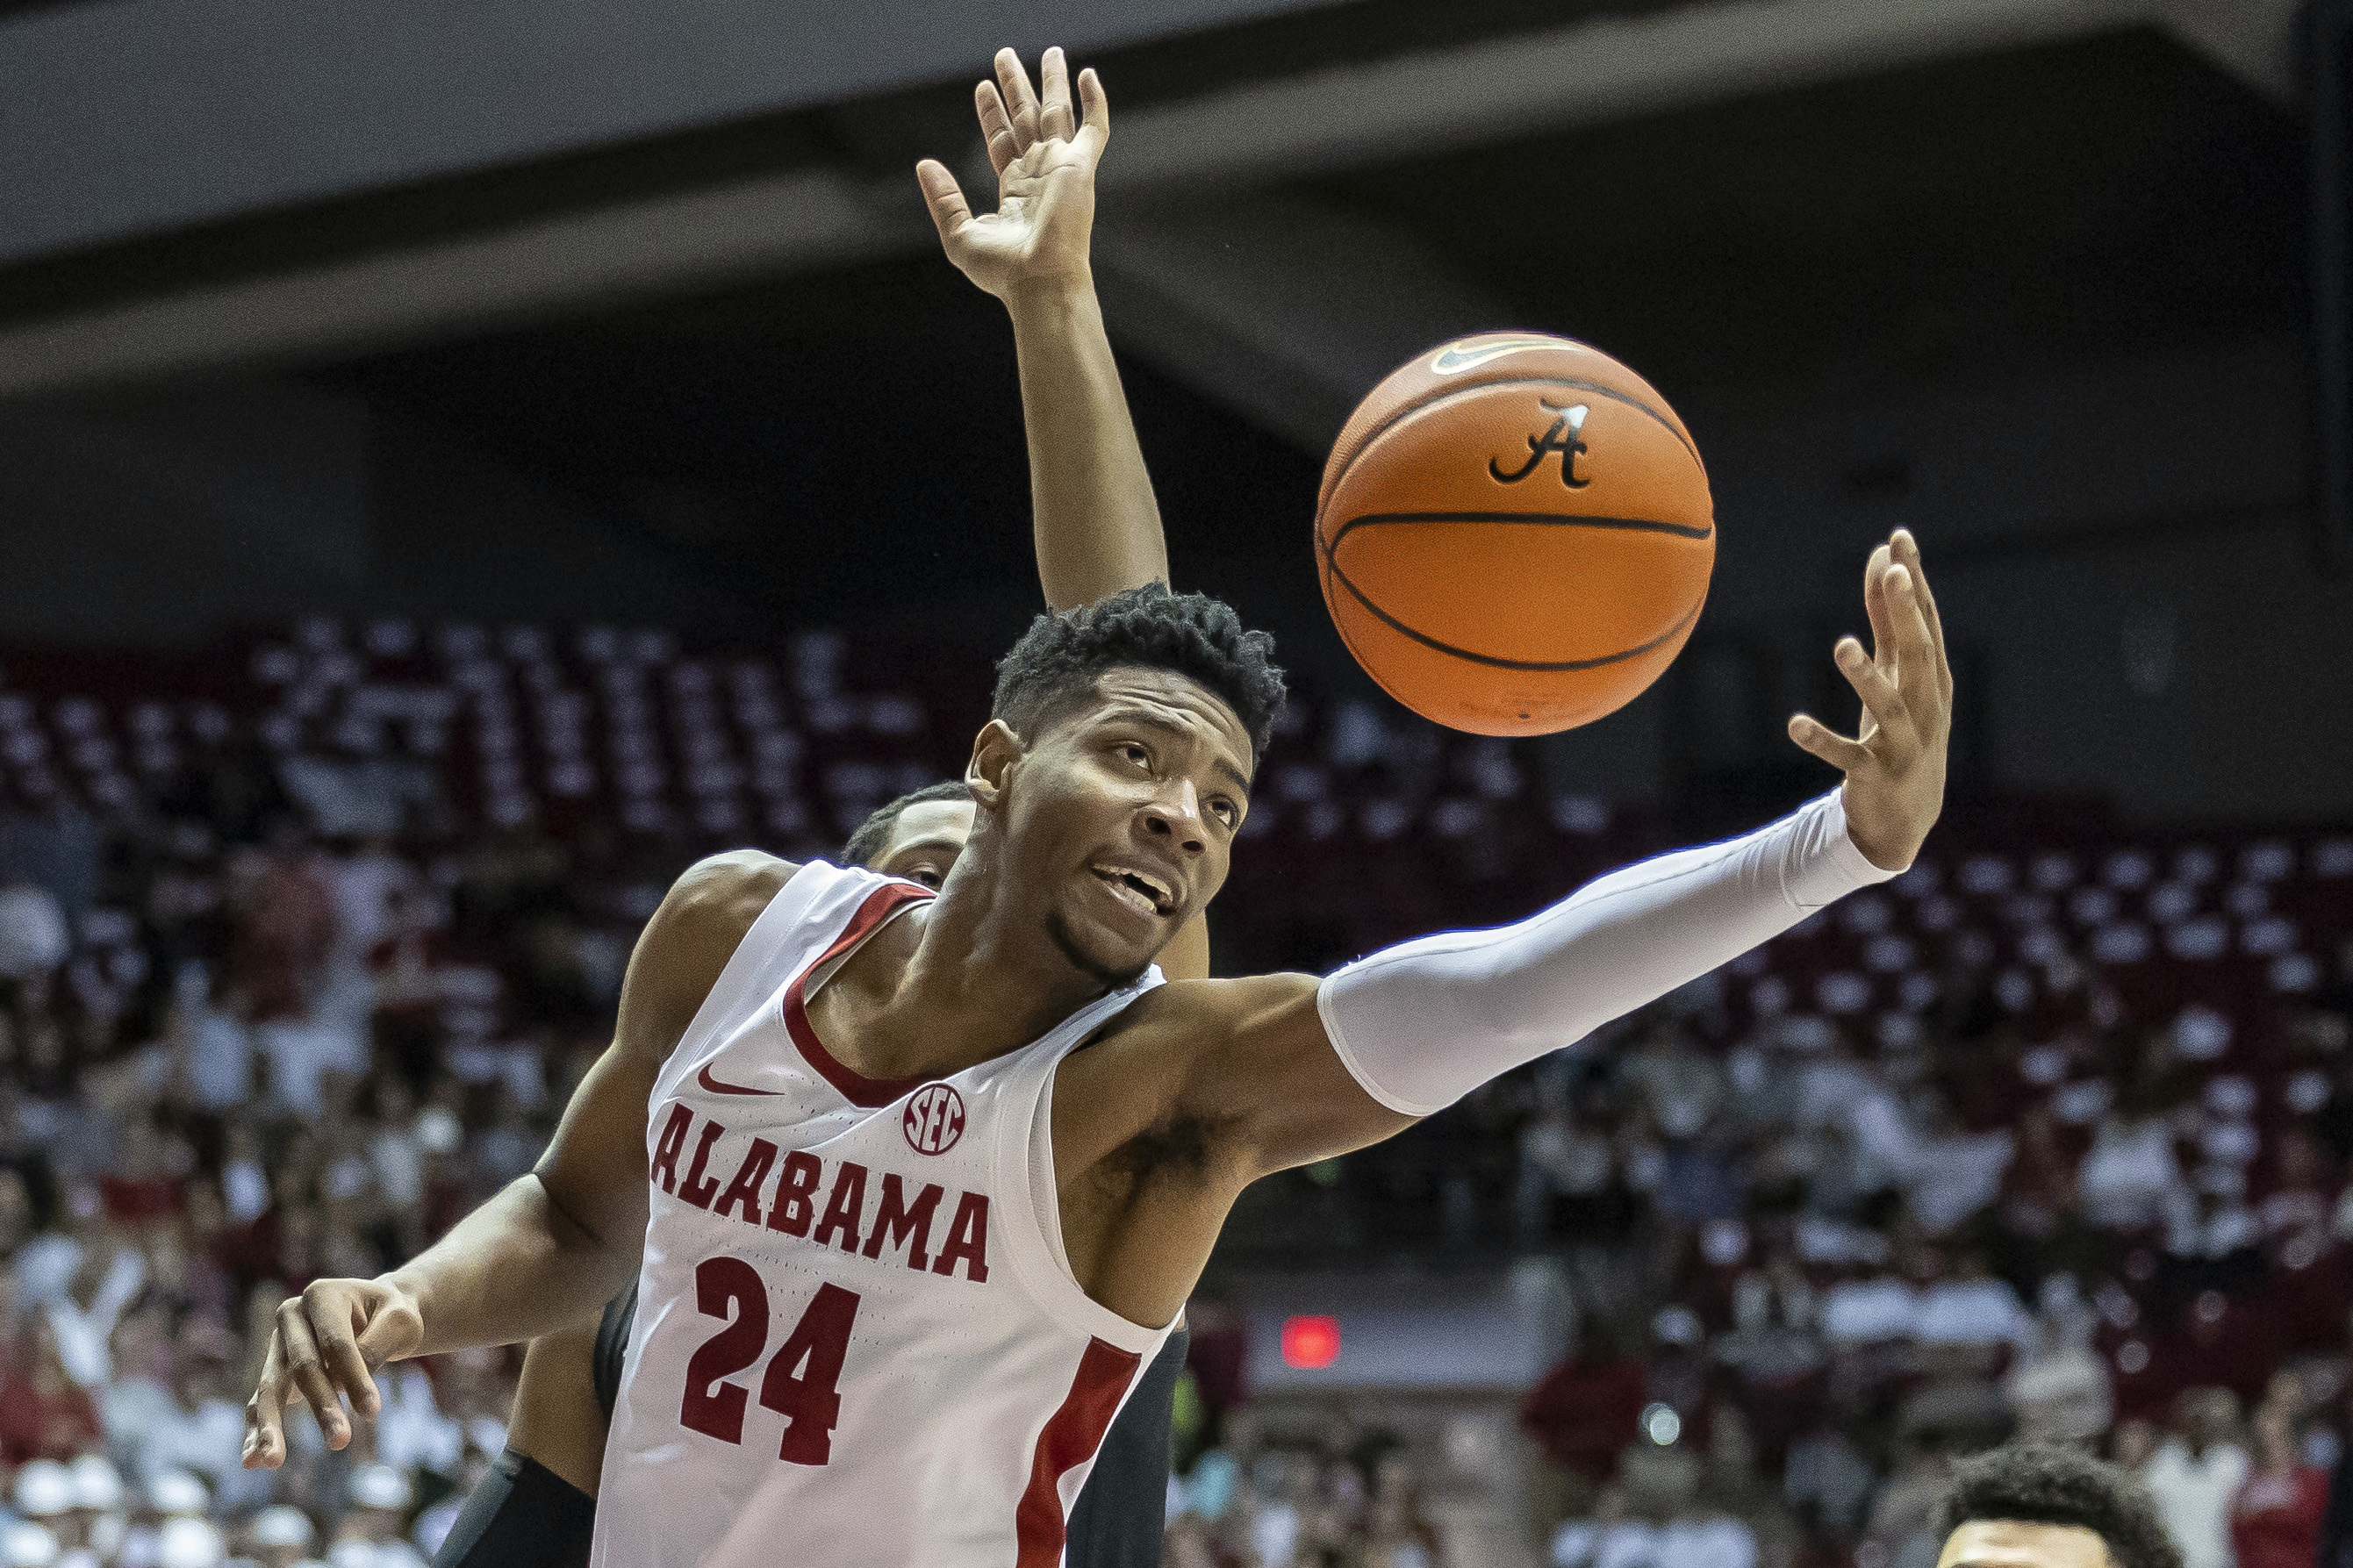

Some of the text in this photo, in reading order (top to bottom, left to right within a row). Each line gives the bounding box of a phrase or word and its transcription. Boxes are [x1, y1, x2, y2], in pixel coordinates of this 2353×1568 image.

[1489, 397, 1591, 489] A
[905, 1086, 963, 1152] SEC
[650, 1101, 990, 1284] ALABAMA
[679, 1256, 861, 1466] 24
